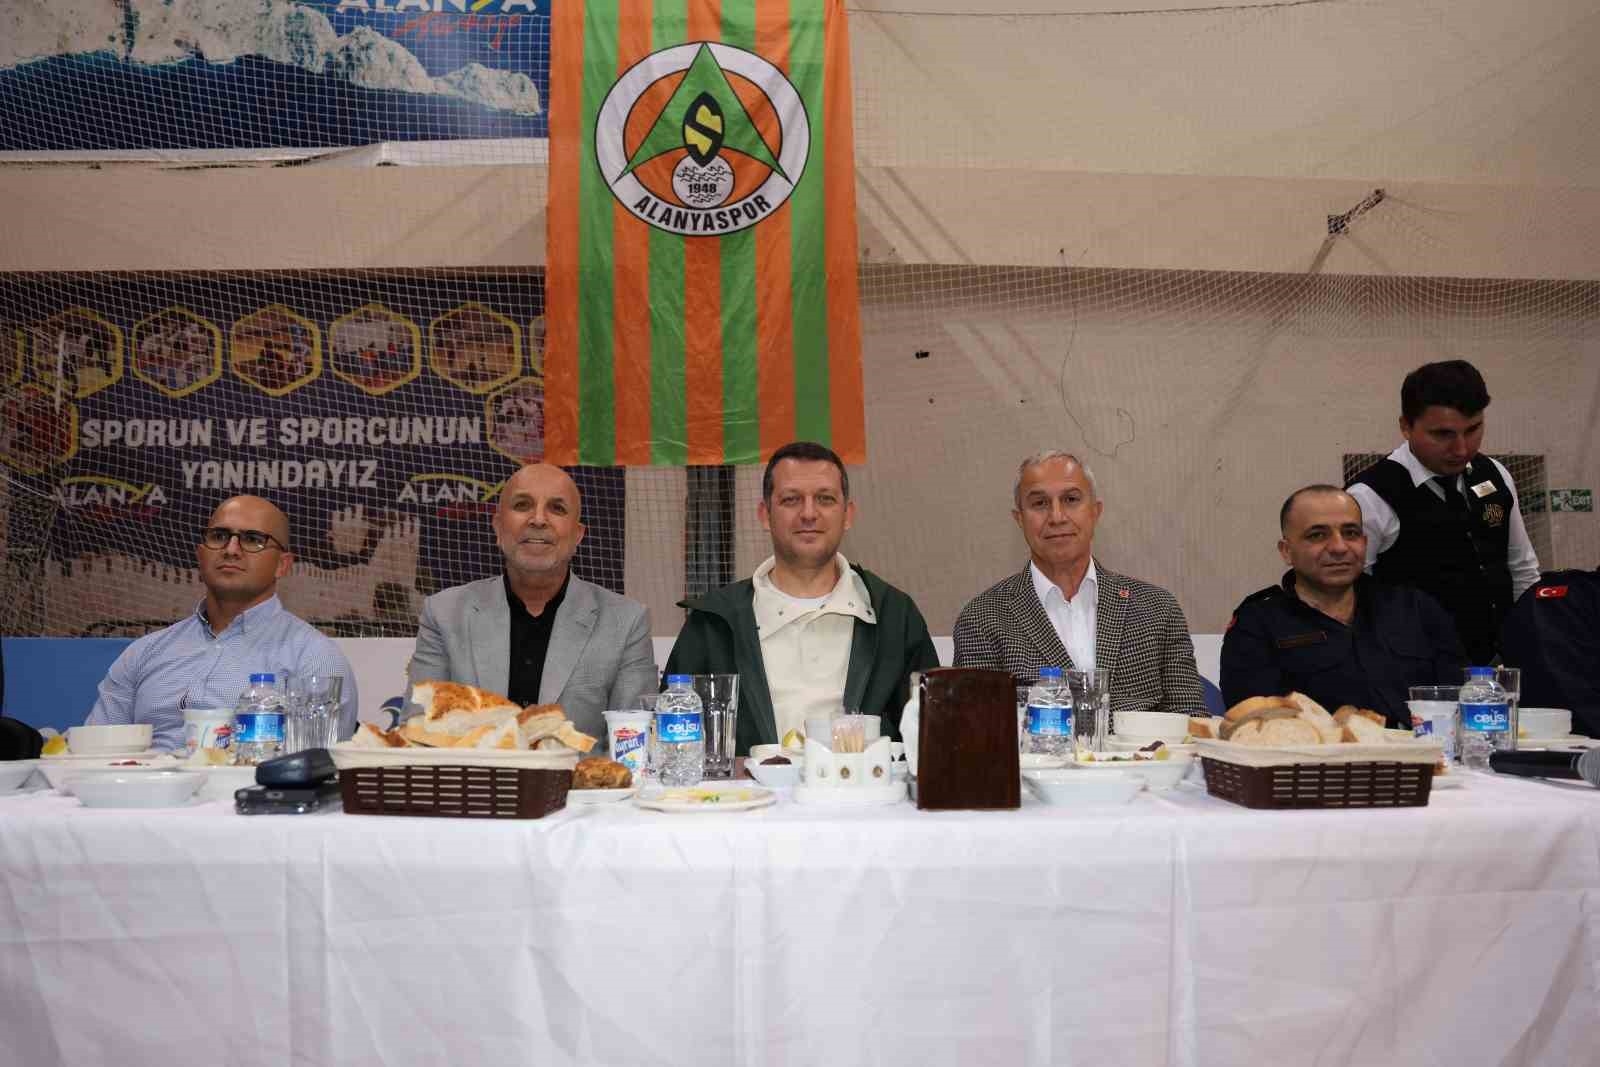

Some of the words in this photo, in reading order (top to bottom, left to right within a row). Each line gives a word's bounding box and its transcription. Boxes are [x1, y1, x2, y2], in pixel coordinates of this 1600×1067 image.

[688, 183, 716, 193] 1948
[634, 195, 772, 230] ALANYASPOR
[81, 418, 212, 447] SPORUN
[226, 417, 267, 446] VE
[280, 416, 480, 445] SPORCUNUN
[181, 459, 378, 488] YANINDAYIZ
[398, 480, 506, 504] ALANY
[1474, 709, 1506, 725] ceys
